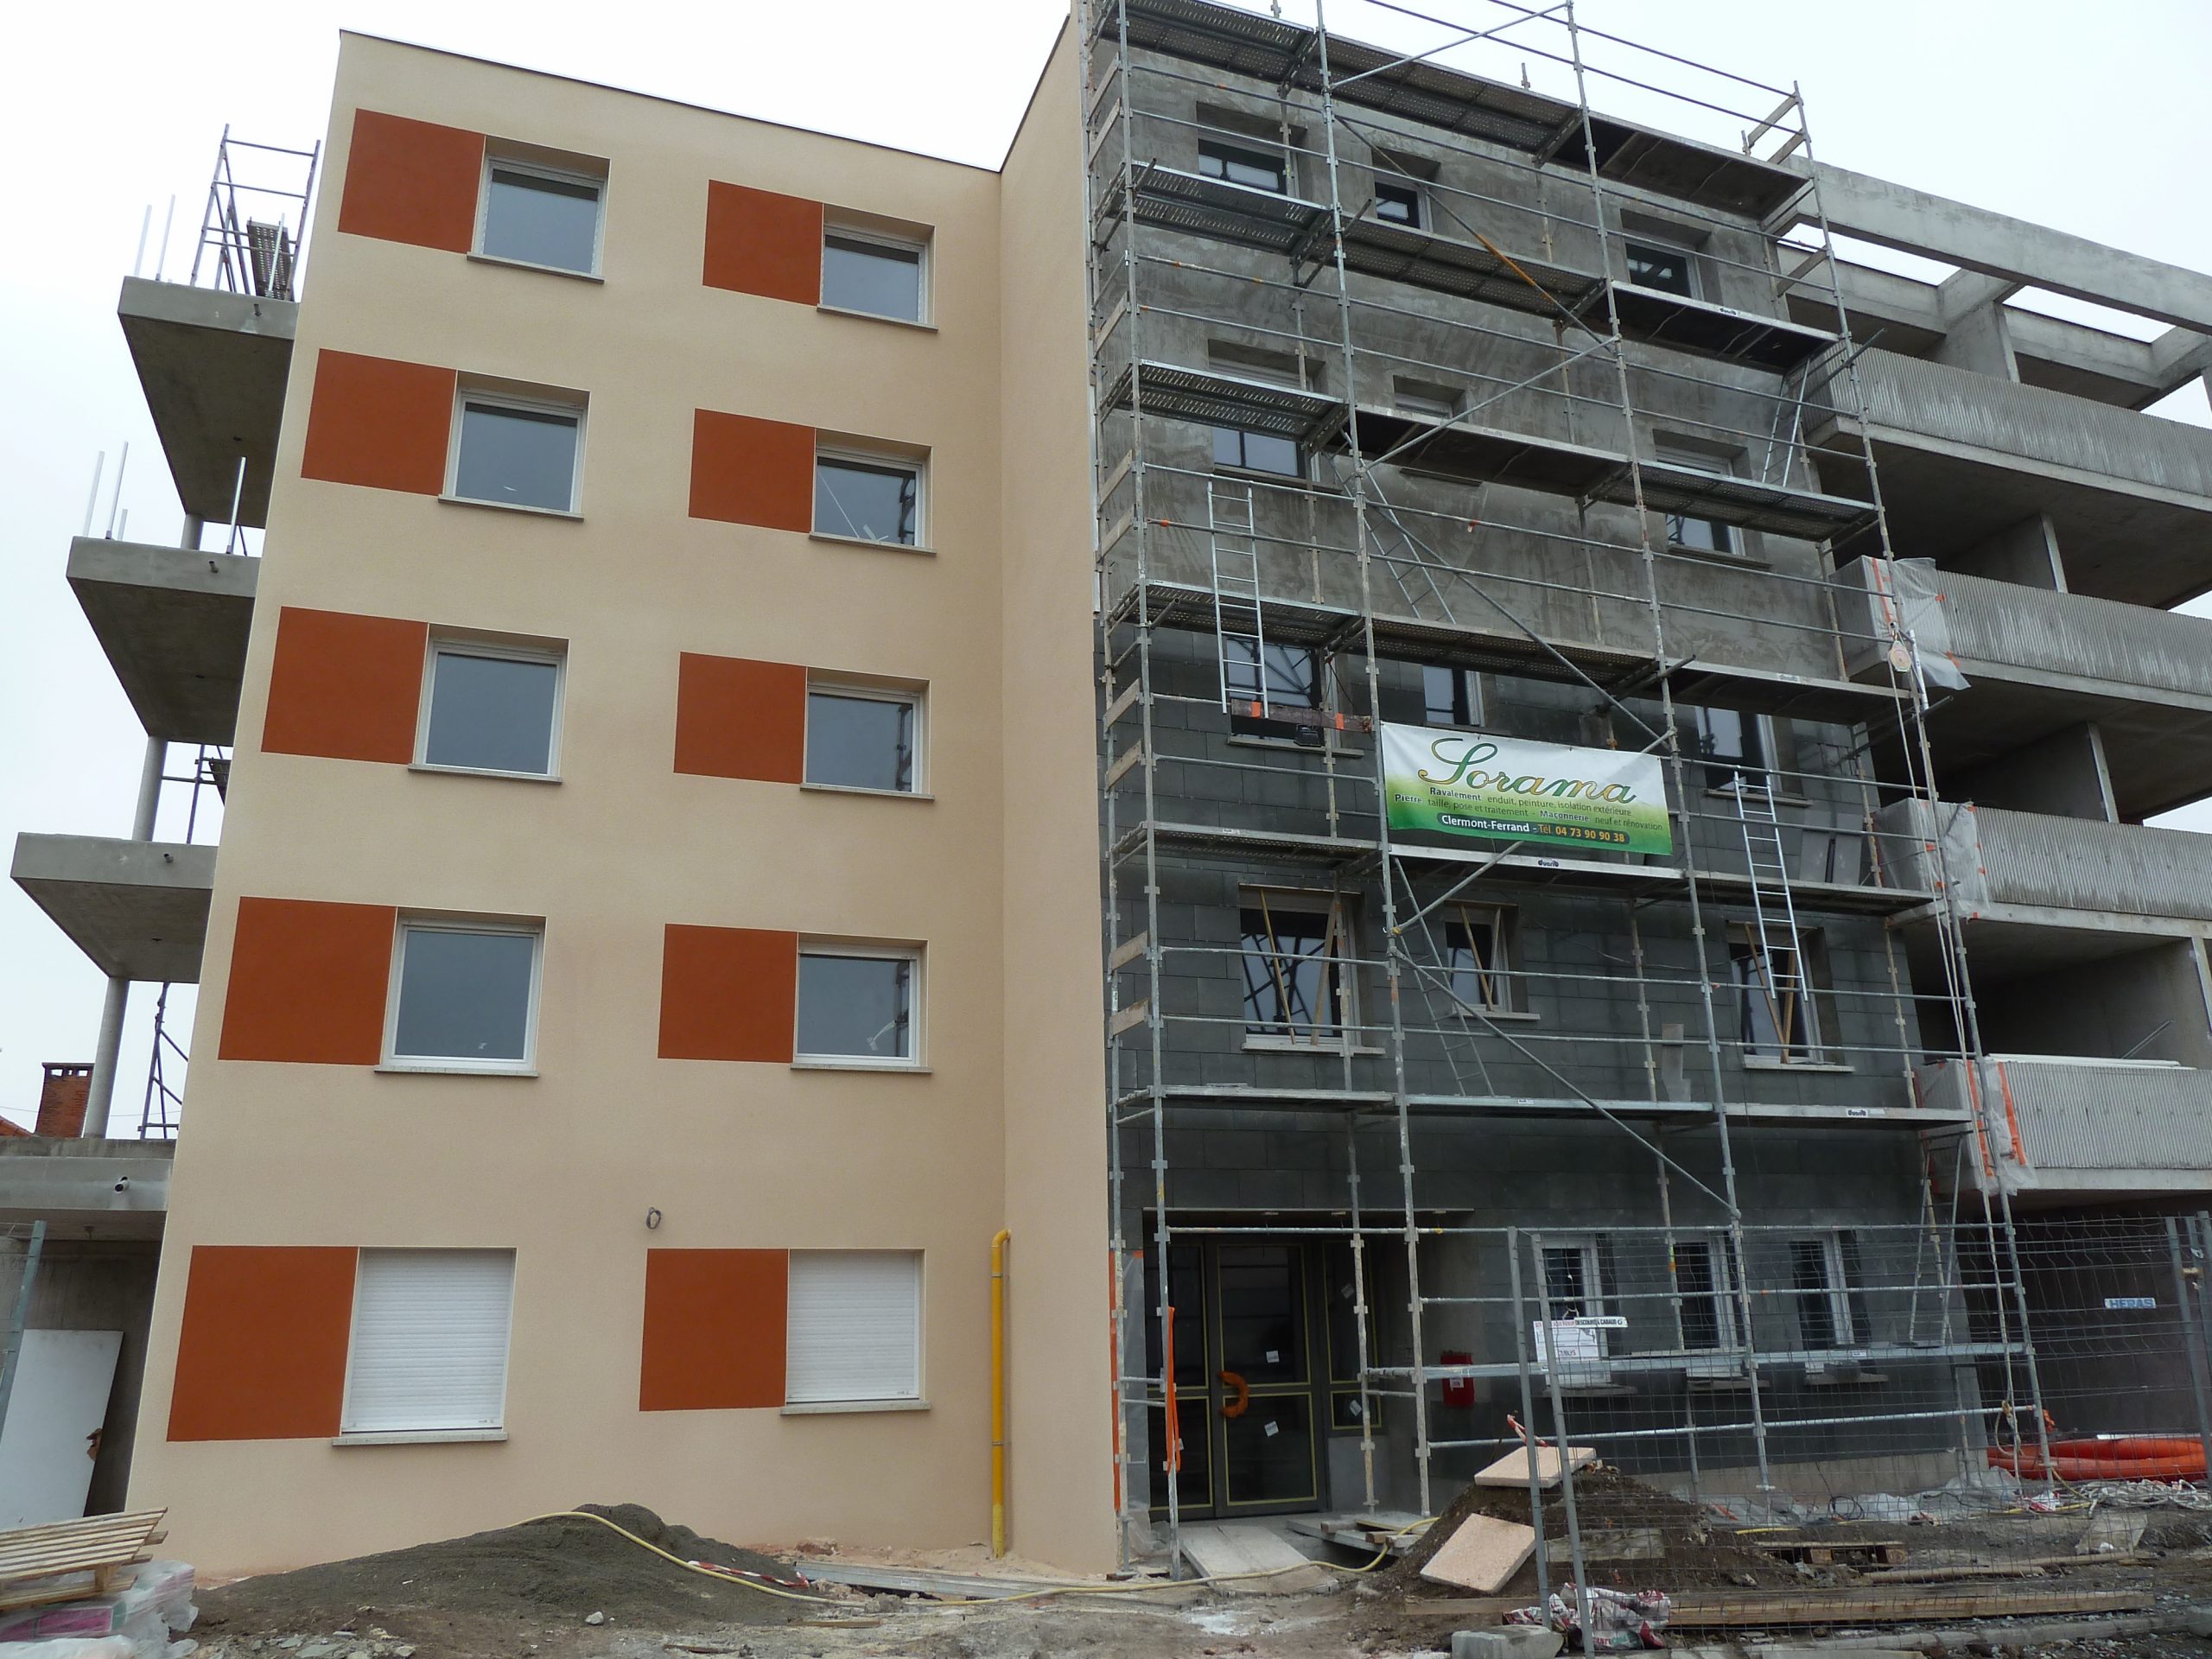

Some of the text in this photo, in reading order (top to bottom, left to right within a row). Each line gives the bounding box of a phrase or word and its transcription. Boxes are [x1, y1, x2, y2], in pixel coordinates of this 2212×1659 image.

[1395, 794, 1422, 803] Pierre
[1428, 798, 1451, 810] taille,
[1453, 802, 1472, 810] pose
[1484, 806, 1529, 817] traitement
[1540, 810, 1590, 822] Maçonnerie
[1595, 817, 1613, 826] neuf
[1624, 819, 1663, 830] rénovation
[1430, 787, 1632, 817] Ravalement enduit, peinture, isolation extérieure
[1441, 815, 1530, 832] Clermont-Ferrand
[1555, 826, 1567, 836] 04
[1570, 828, 1581, 837] 73
[1585, 830, 1597, 839] 90
[1599, 831, 1611, 841] 90
[1613, 833, 1625, 842] 38
[2110, 1300, 2153, 1309] HERAS
